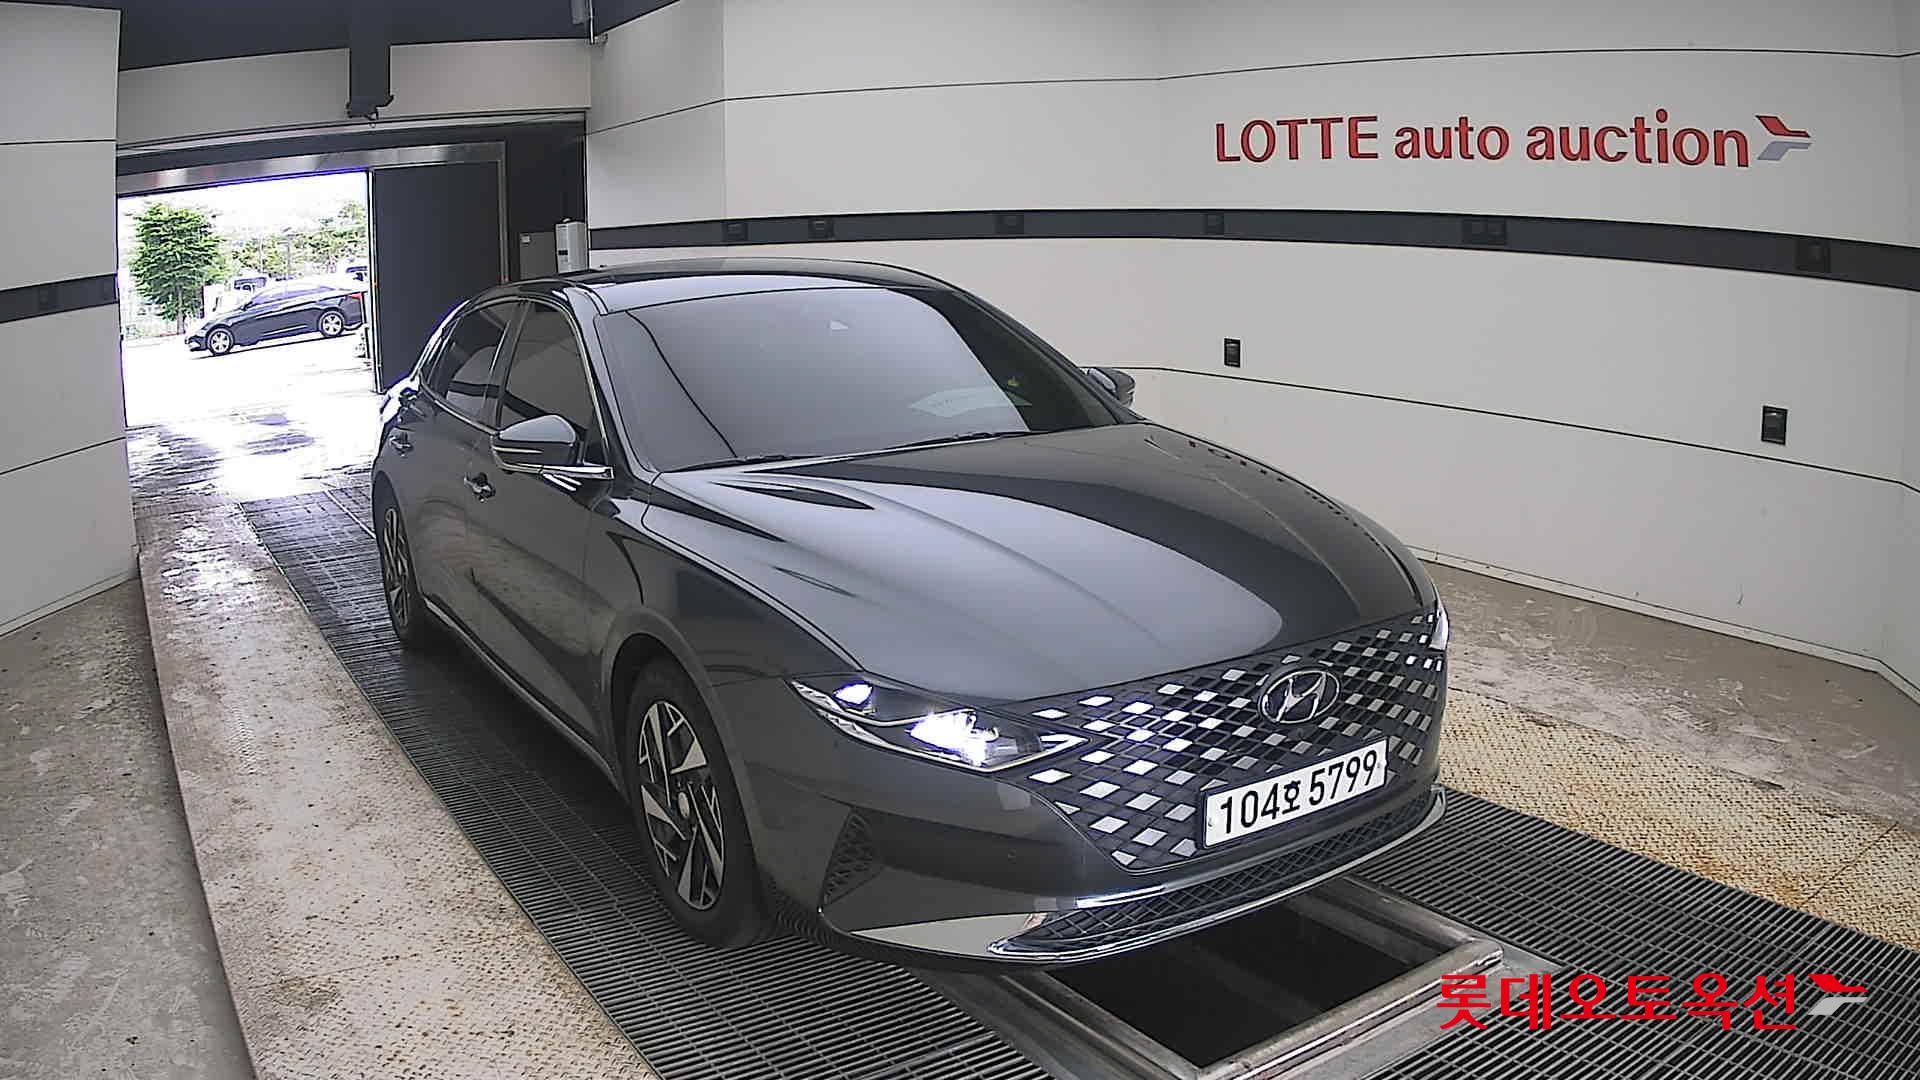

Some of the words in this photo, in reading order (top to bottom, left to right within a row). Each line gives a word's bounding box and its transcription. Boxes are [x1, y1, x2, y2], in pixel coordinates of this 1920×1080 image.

[1216, 116, 1378, 163] LOTTE
[1395, 117, 1510, 160] auto
[1527, 108, 1749, 167] auction
[1220, 779, 1301, 834] 104호
[1309, 749, 1378, 806] 5799
